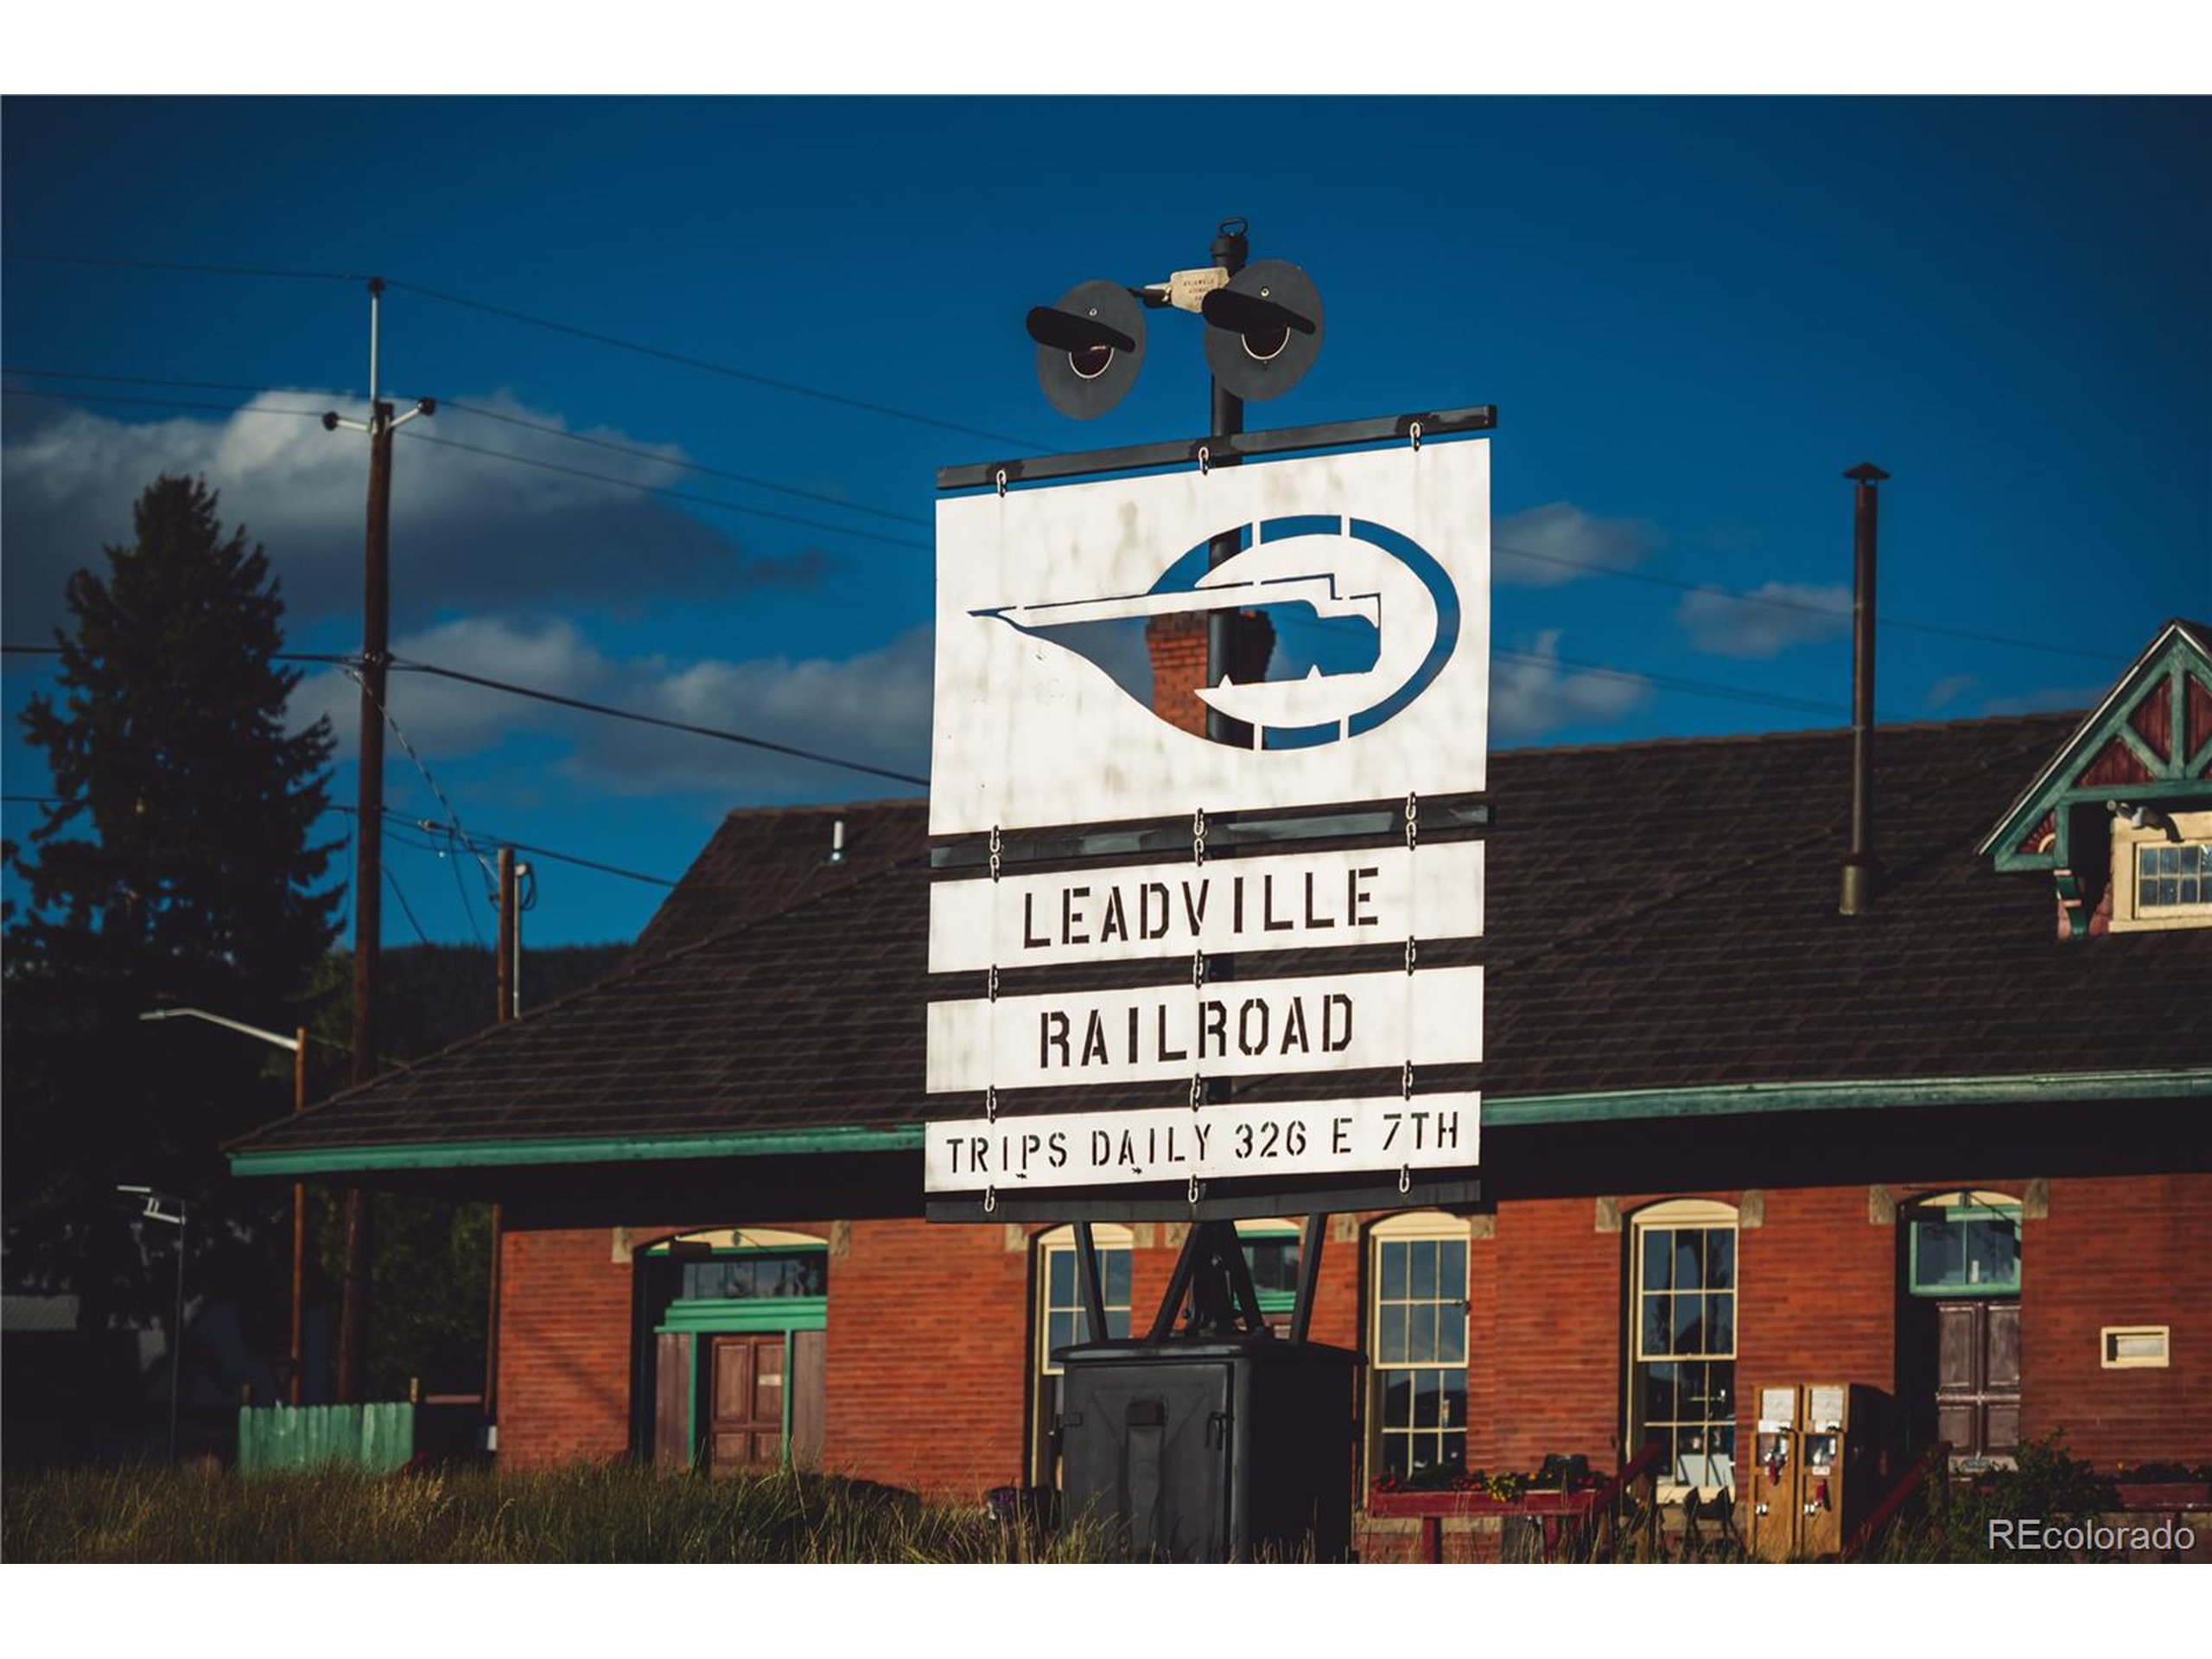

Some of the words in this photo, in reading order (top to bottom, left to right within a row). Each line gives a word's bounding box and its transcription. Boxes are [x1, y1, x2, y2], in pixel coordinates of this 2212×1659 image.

[1023, 867, 1379, 949] LEADVILLE
[1040, 993, 1353, 1069] RAILROAD
[945, 1131, 1068, 1173] TRIPS
[1092, 1123, 1211, 1166] DAILY
[1235, 1120, 1306, 1160] 326
[1332, 1117, 1353, 1154] E
[1382, 1110, 1459, 1152] 7TH
